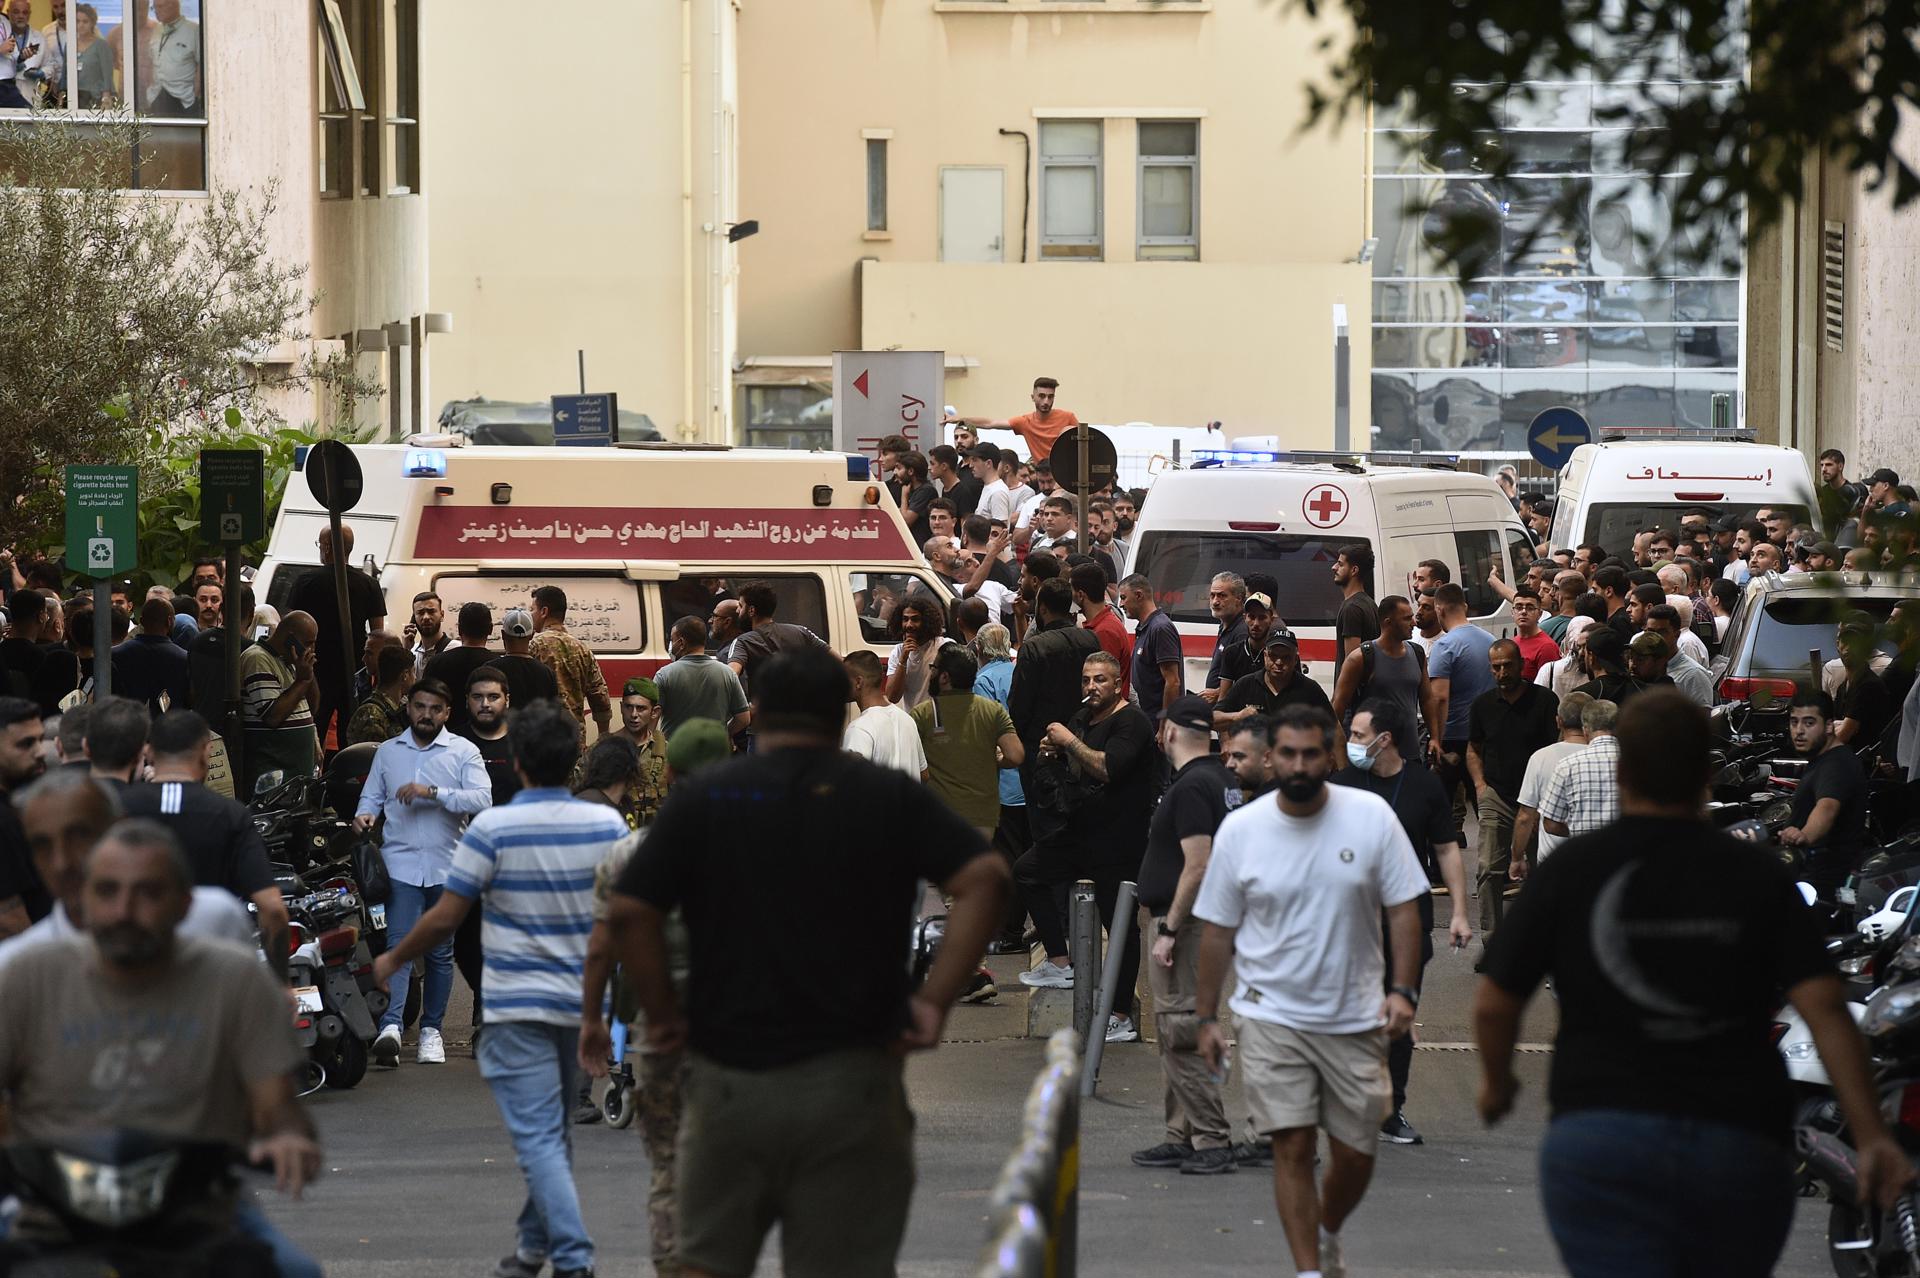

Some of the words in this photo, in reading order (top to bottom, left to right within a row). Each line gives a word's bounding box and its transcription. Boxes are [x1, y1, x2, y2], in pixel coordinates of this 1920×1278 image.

[94, 474, 113, 482] recycle
[1626, 466, 1772, 486] إسعاف
[457, 522, 507, 543] زعيتر
[508, 518, 572, 545] ناصيف
[573, 523, 614, 543] حسن
[616, 521, 667, 545] مهدي
[668, 520, 710, 543] الحاج
[713, 519, 768, 543] الشهيد
[769, 523, 801, 543] روح
[802, 523, 827, 544] عن
[831, 519, 880, 541] تقدمة
[1274, 629, 1291, 638] AUB
